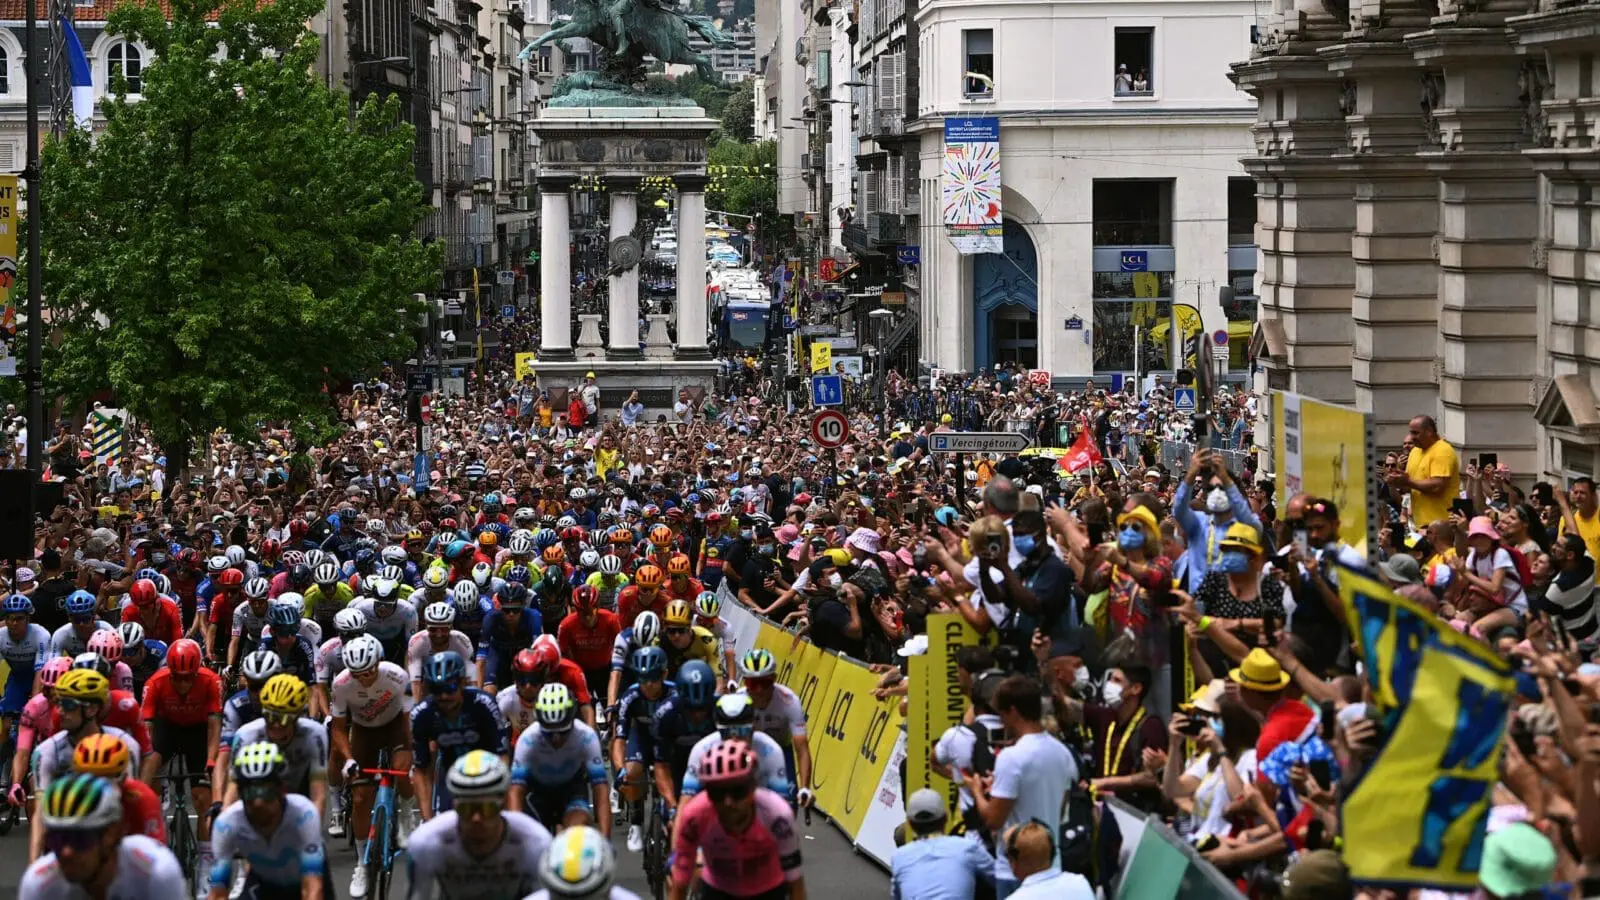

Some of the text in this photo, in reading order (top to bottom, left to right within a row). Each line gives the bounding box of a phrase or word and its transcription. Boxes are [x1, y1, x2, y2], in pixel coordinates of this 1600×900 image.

[505, 307, 511, 316] P
[820, 420, 841, 438] 10
[937, 438, 1018, 450] P Vercingétorix
[826, 688, 854, 741] LCL
[861, 706, 890, 765] LCL
